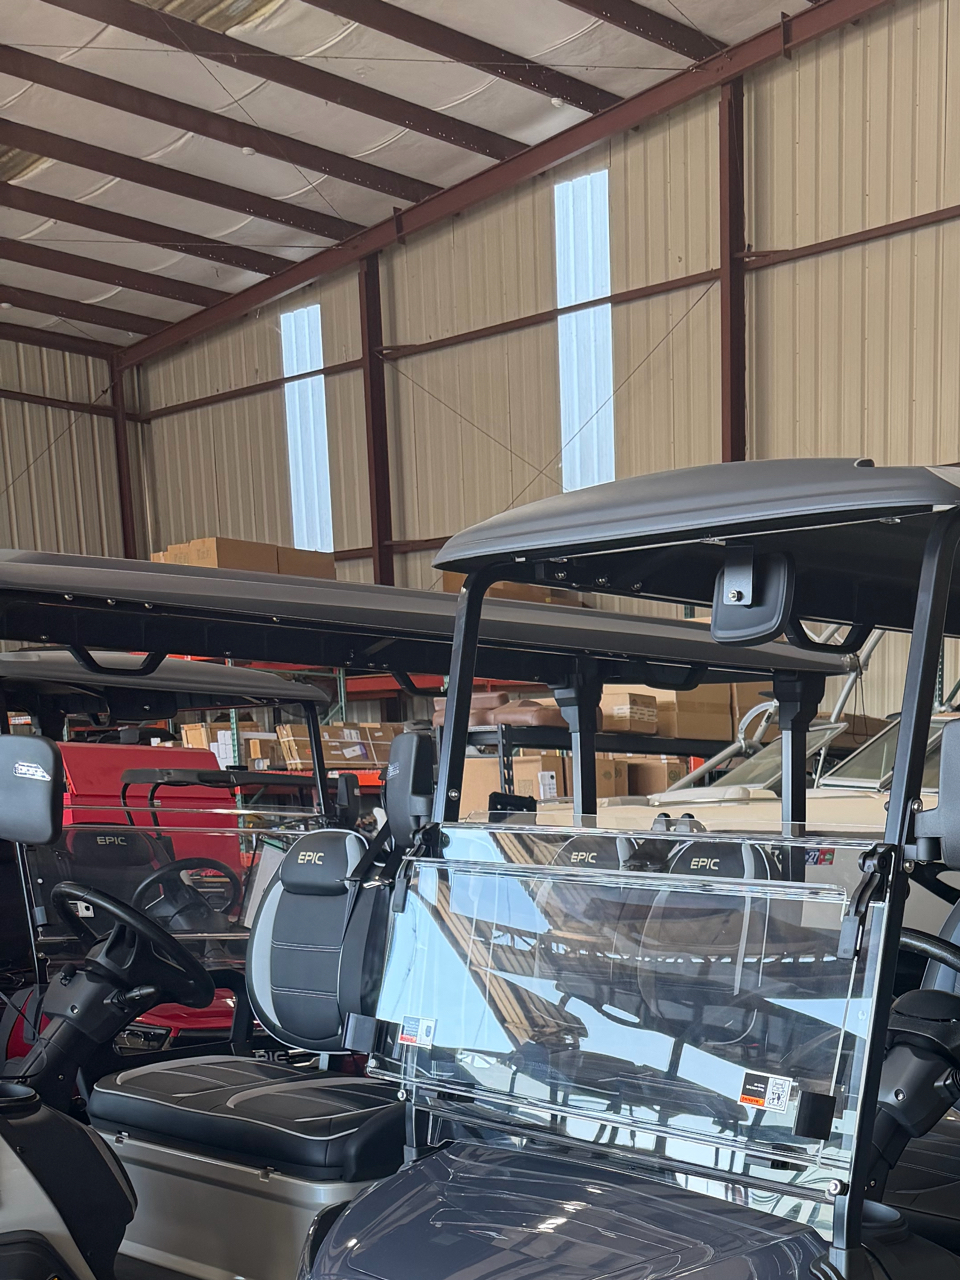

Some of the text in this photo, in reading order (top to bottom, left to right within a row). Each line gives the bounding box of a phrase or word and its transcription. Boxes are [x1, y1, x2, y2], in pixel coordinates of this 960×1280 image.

[96, 836, 127, 846] EPIC
[297, 851, 324, 865] EPIC
[570, 851, 598, 864] EPIC
[690, 857, 720, 870] EPIC
